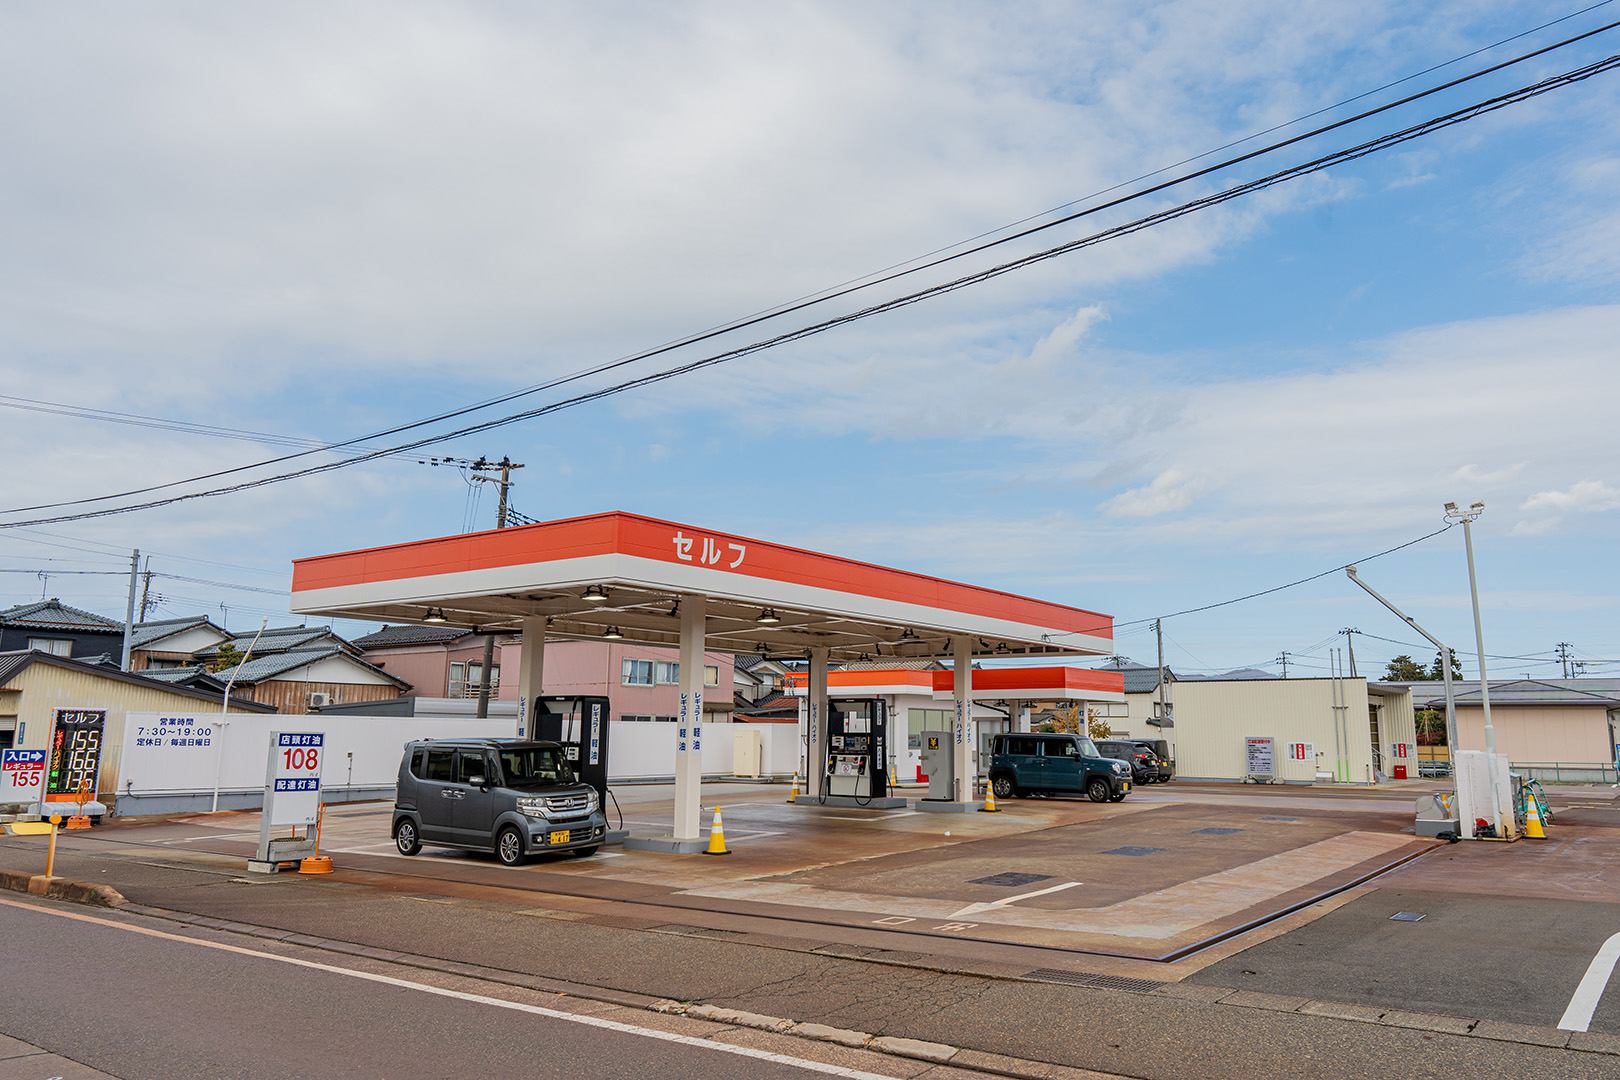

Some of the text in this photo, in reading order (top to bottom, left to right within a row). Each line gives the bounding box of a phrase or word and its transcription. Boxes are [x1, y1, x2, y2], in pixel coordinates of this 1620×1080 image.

[672, 531, 746, 569] セルフ
[62, 712, 100, 724] セルフ
[159, 717, 194, 726] 営業時間
[678, 693, 688, 751] レギュラー 軽油
[71, 730, 99, 750] 155
[280, 735, 321, 745] 店頭灯油
[590, 705, 600, 760] レギュラー 軽油
[692, 727, 701, 750] 軽油
[6, 751, 30, 762] 入口
[68, 750, 95, 770] 166
[283, 748, 318, 770] 108
[11, 772, 40, 787] 155
[276, 779, 317, 790] 配達灯油
